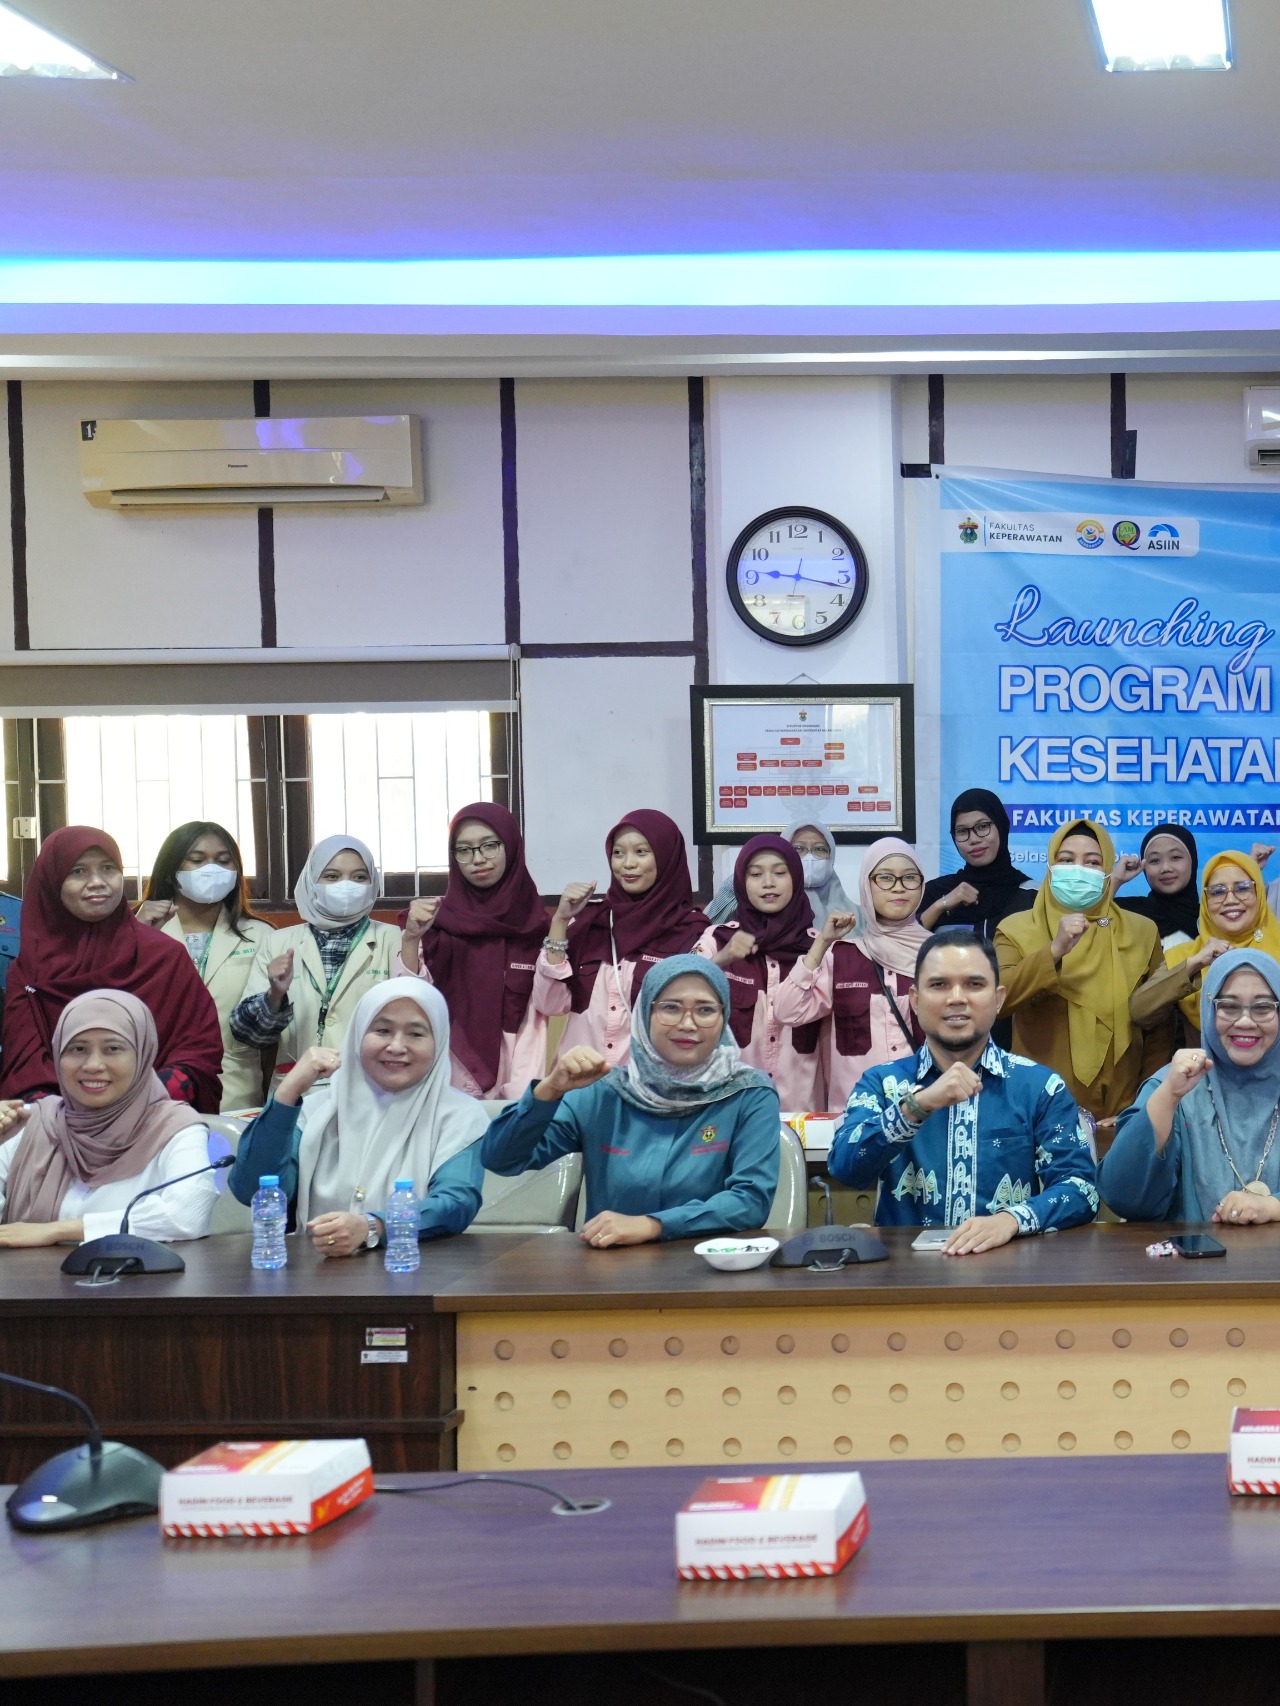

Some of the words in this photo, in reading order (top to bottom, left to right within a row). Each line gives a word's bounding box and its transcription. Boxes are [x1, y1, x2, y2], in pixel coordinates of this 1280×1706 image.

[787, 524, 809, 539] 12
[989, 522, 1035, 532] FAKULTAS
[769, 530, 780, 544] 11
[818, 530, 823, 543] 1
[989, 532, 1063, 543] KEPERAWATAN
[1147, 539, 1180, 550] ASIIN
[752, 547, 769, 561] 10
[831, 547, 845, 561] 2
[745, 569, 760, 586] 9
[837, 569, 851, 585] 3
[753, 594, 767, 607] 8
[829, 593, 845, 607] 4
[769, 611, 781, 625] 7
[791, 614, 806, 630] 6
[815, 610, 828, 625] 5
[995, 585, 1274, 673] Launching
[1000, 664, 1271, 712] PROGRAM
[1012, 809, 1122, 827] FAKULTAS
[1010, 849, 1048, 863] Selas
[819, 1232, 856, 1243] BOSCH
[106, 1242, 145, 1251] BOSCH
